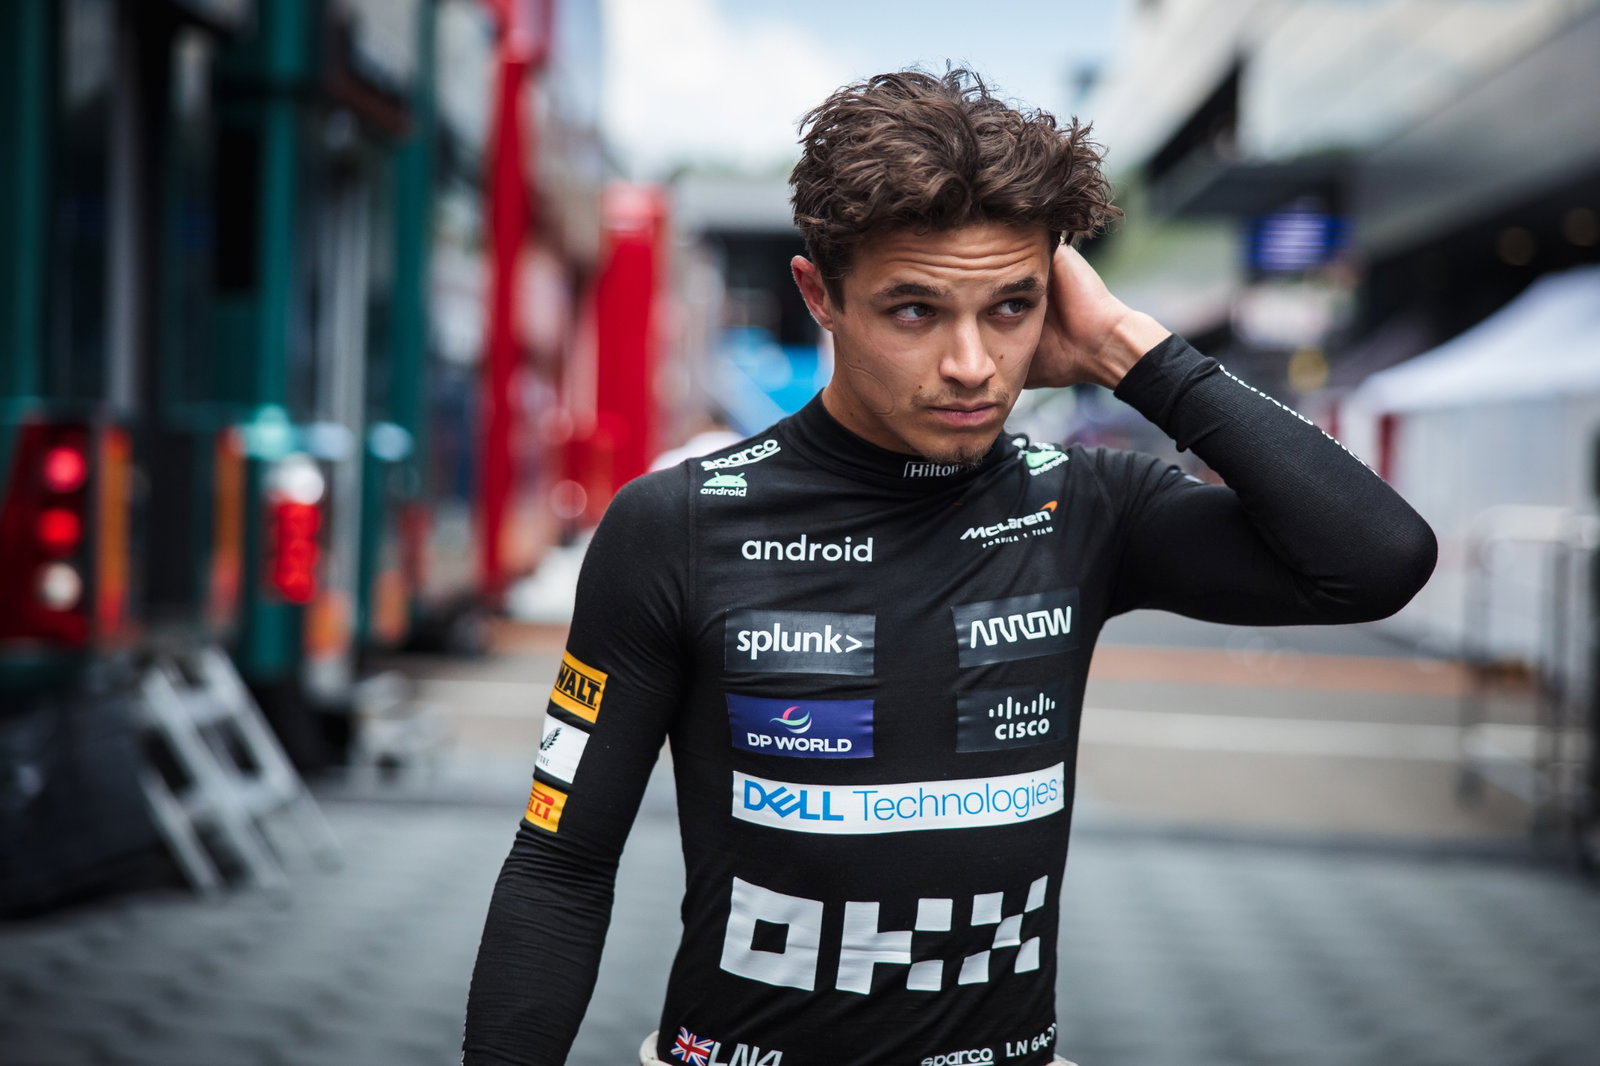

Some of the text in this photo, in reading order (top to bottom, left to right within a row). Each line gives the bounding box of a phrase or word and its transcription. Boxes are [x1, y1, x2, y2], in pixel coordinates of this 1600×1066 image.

[701, 439, 781, 471] sparco
[700, 487, 747, 497] android
[960, 510, 1052, 540] McLaren
[1032, 526, 1054, 536] TEAM
[741, 534, 873, 562] android
[970, 606, 1071, 649] ARROW
[747, 733, 852, 752] DP WORLD
[743, 778, 1057, 821] DELL Technologies
[719, 875, 1048, 995] OKX
[921, 1047, 994, 1066] sparco
[1006, 1040, 1028, 1057] LN
